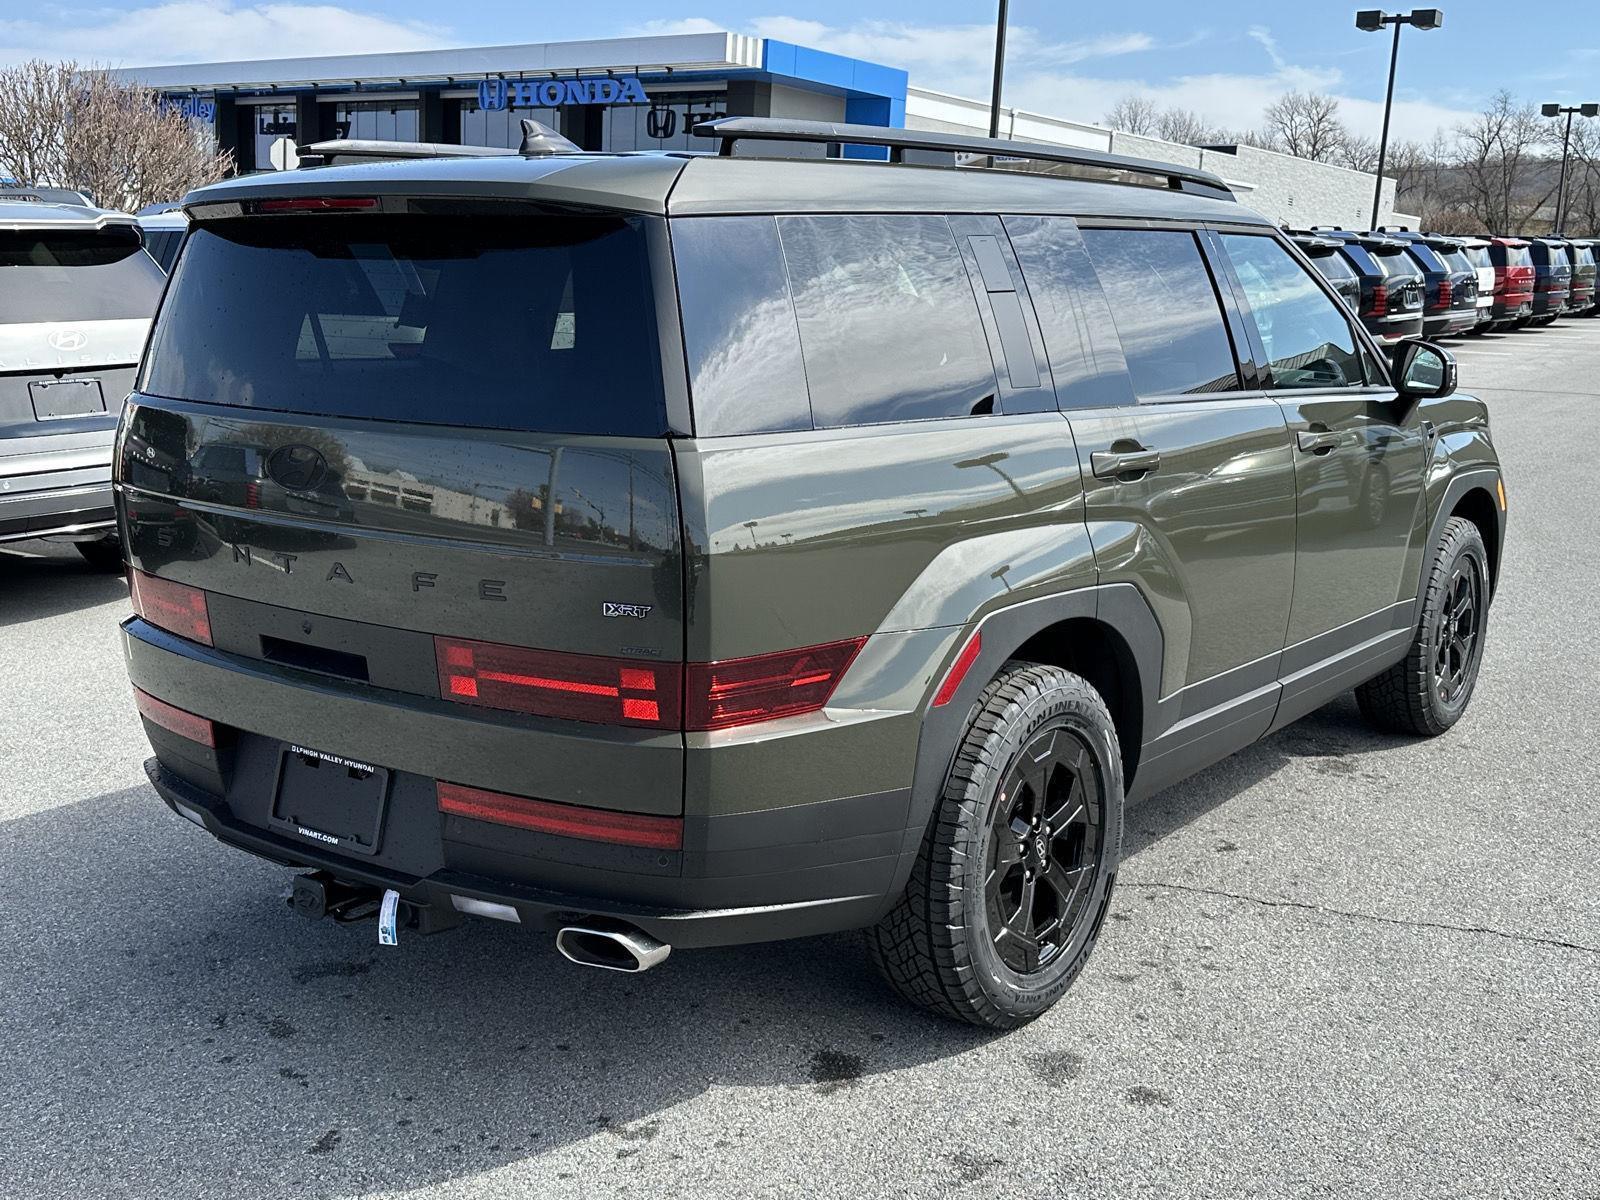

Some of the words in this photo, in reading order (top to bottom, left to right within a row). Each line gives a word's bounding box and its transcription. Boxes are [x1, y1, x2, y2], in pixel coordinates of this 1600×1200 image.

[512, 77, 650, 107] HONDA
[411, 570, 508, 602] FE
[319, 752, 343, 765] VALLEY
[344, 759, 375, 773] HYUNDAI
[298, 826, 339, 845] VINART.COM
